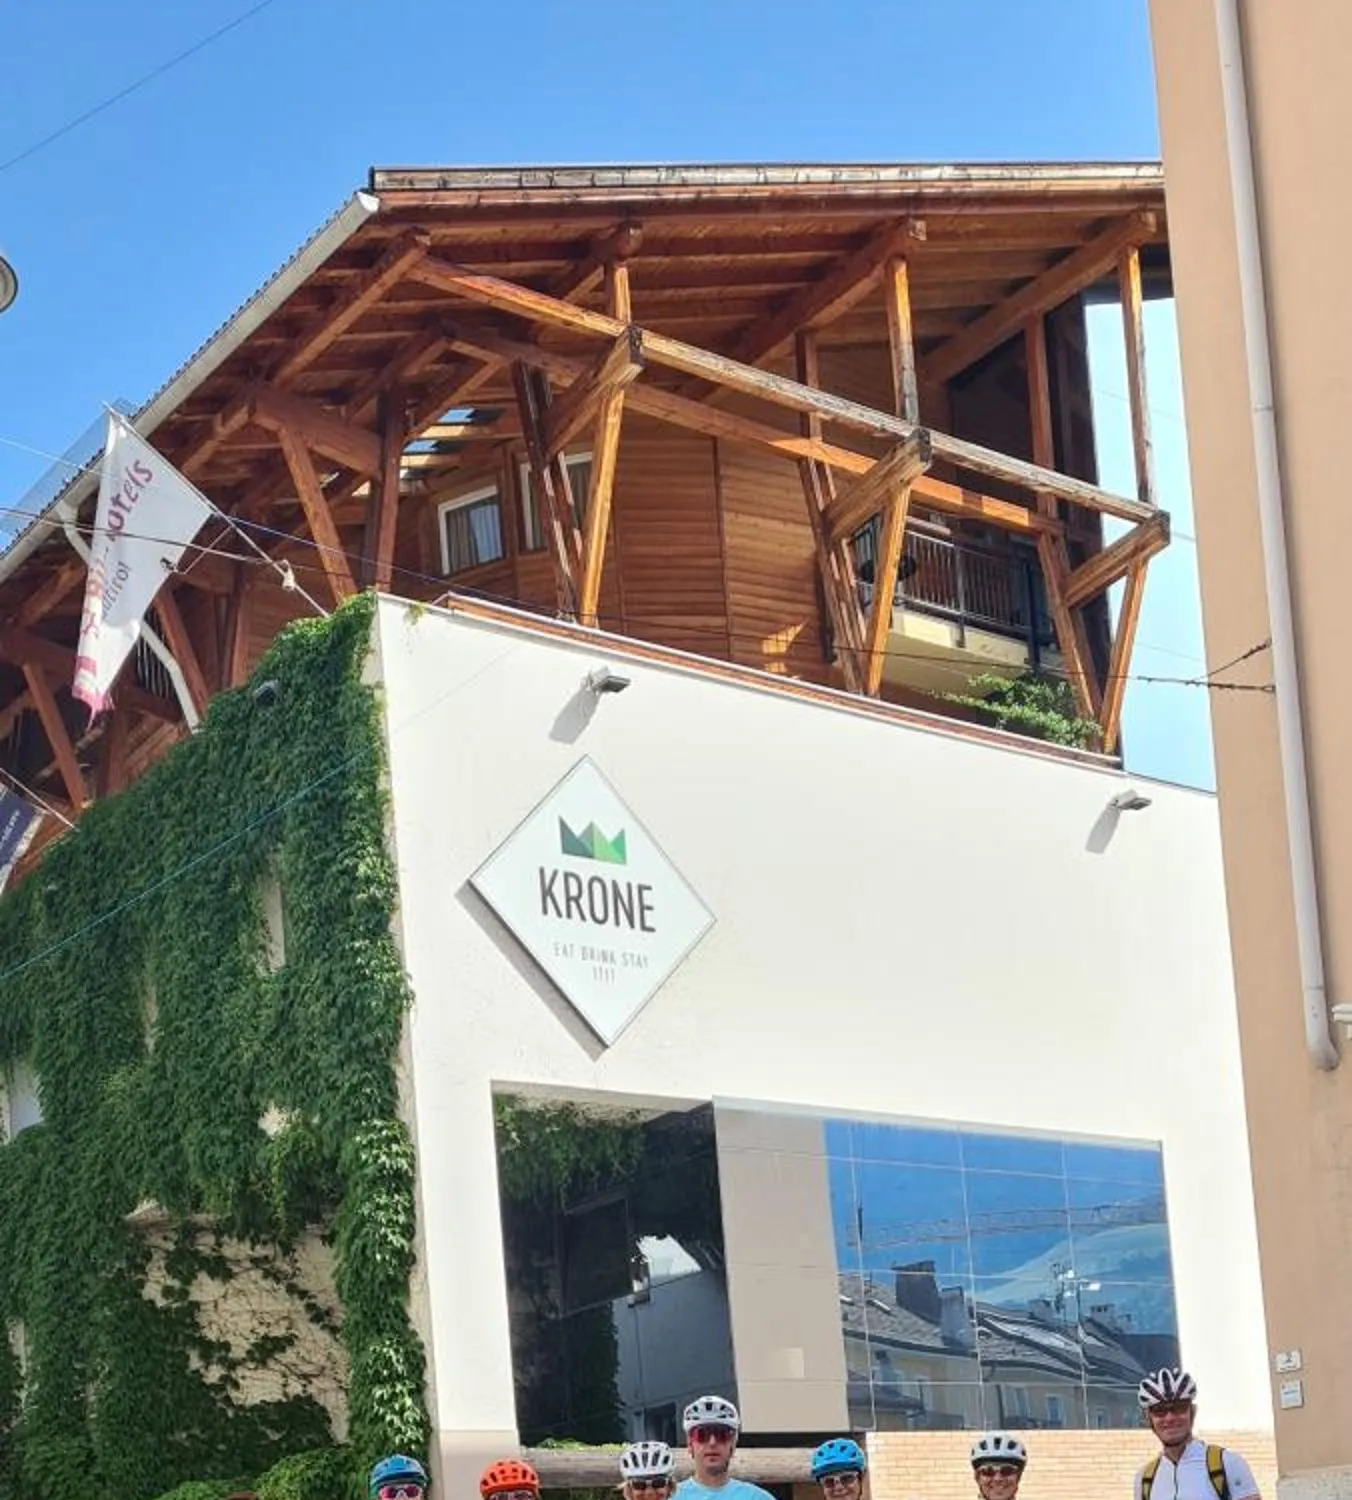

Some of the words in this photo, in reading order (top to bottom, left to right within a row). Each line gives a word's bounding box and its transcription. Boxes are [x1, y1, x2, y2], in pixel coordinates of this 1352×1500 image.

[107, 459, 153, 543] otels
[539, 866, 656, 933] KRONE
[553, 942, 574, 960] EAT
[580, 945, 617, 966] DRINK
[621, 950, 649, 969] STAY
